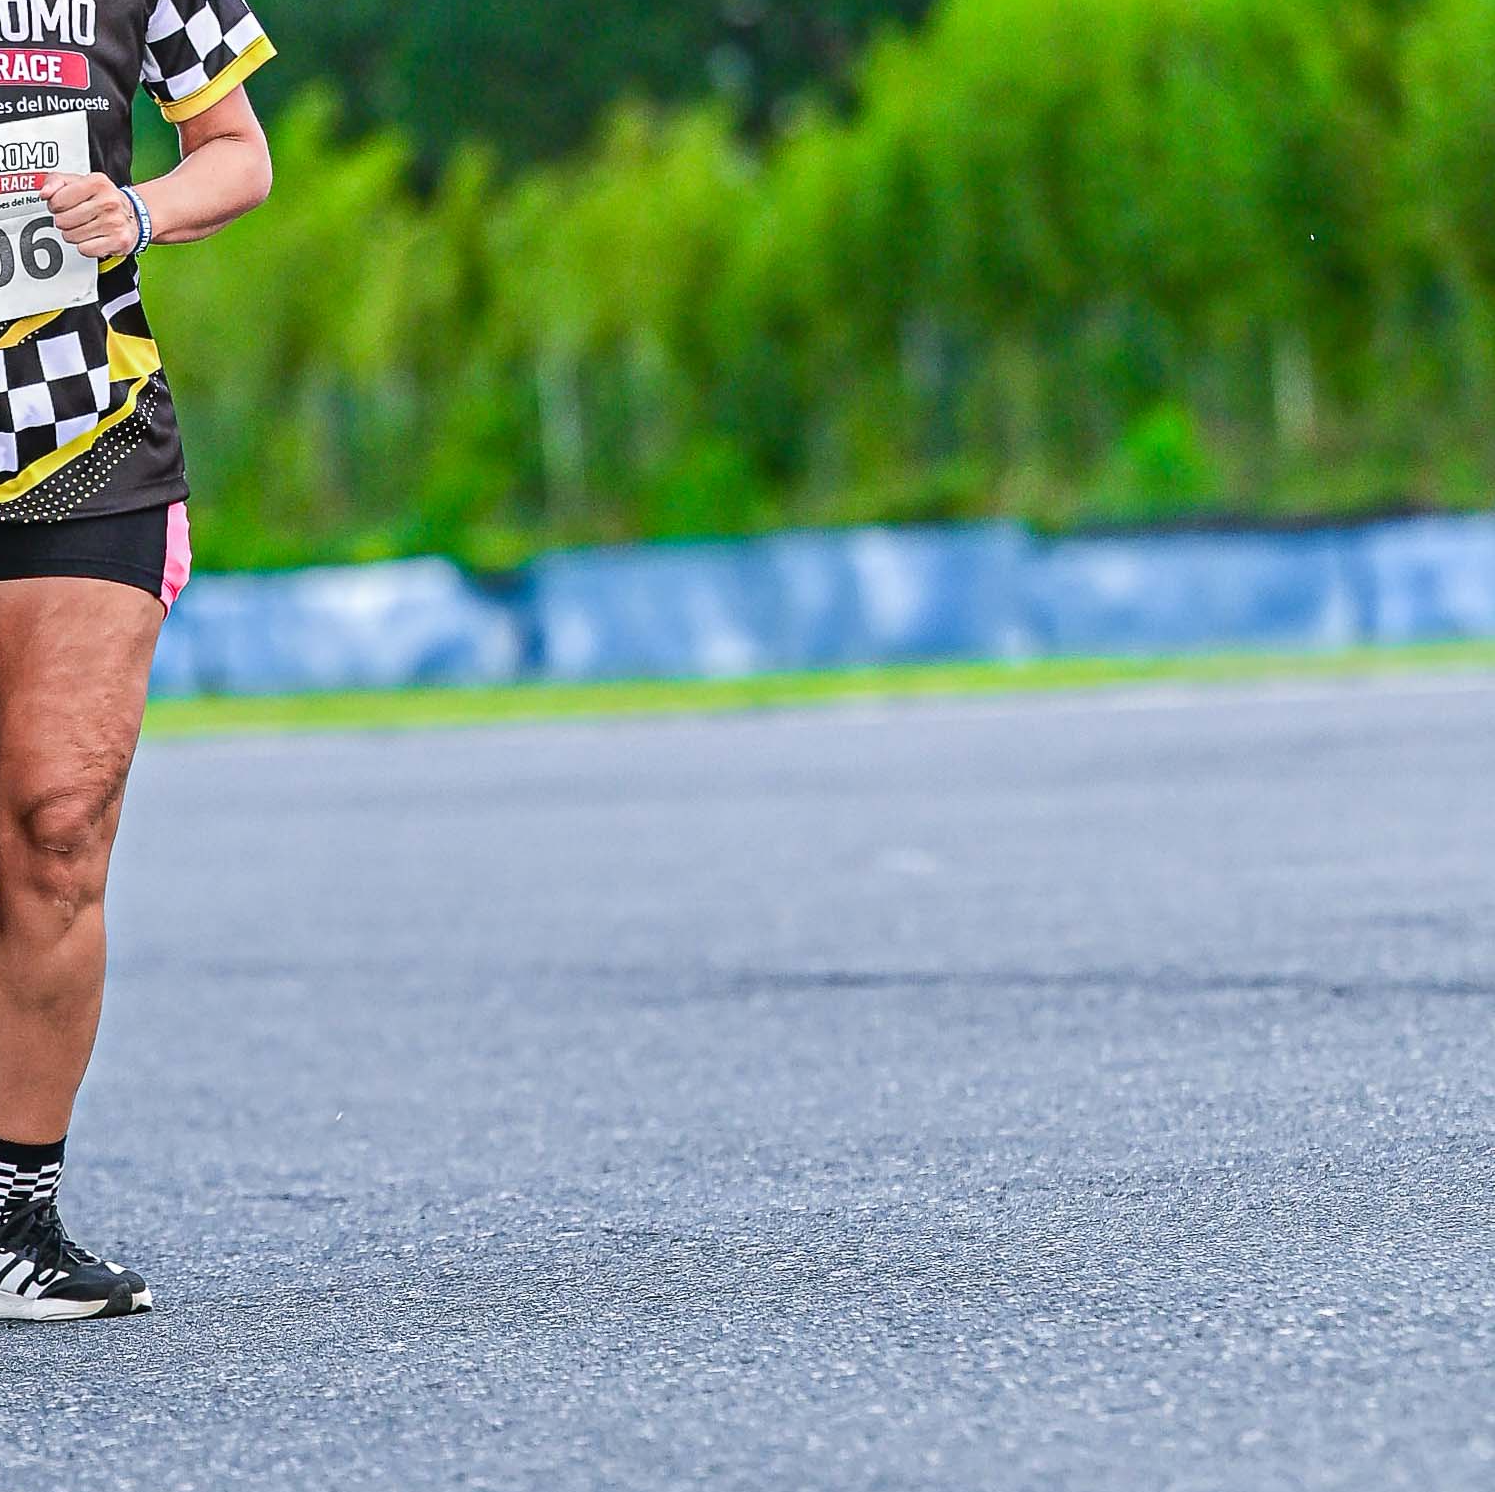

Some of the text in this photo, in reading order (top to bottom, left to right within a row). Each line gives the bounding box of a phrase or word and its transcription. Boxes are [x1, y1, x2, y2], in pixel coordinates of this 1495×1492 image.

[16, 95, 43, 113] del
[46, 94, 110, 113] Noroeste
[1, 175, 36, 192] RACE
[12, 197, 24, 207] del
